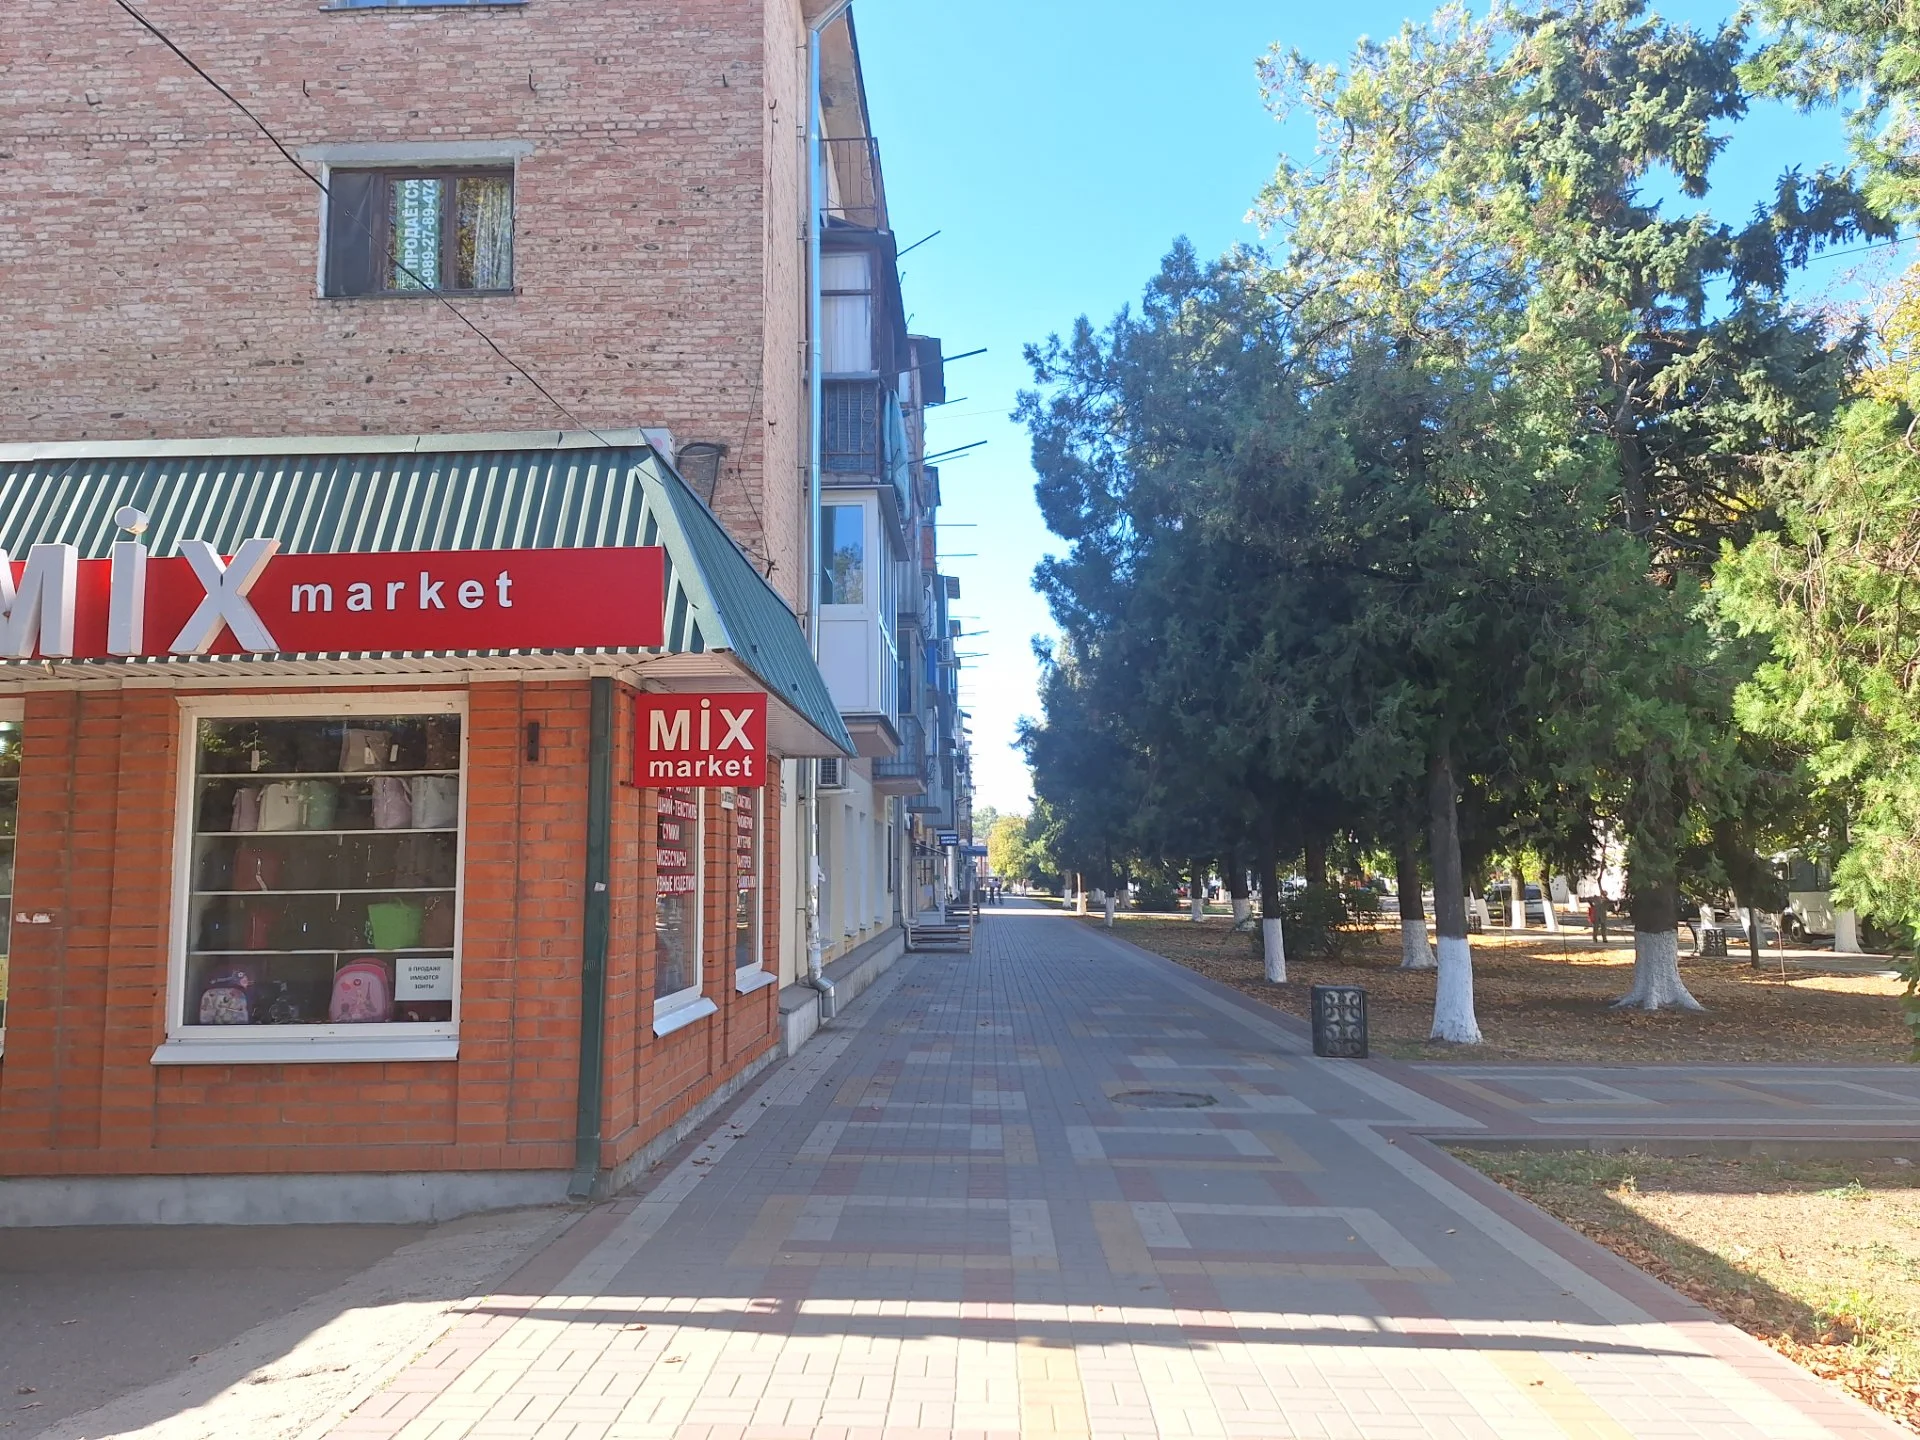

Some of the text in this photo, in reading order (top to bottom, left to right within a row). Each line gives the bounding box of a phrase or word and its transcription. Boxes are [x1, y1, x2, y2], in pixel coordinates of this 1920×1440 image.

[402, 179, 419, 269] ПРОДАЁТСЯ
[290, 570, 515, 614] market
[648, 698, 755, 751] MiX
[648, 754, 753, 778] market
[662, 823, 680, 840] СУМКИ
